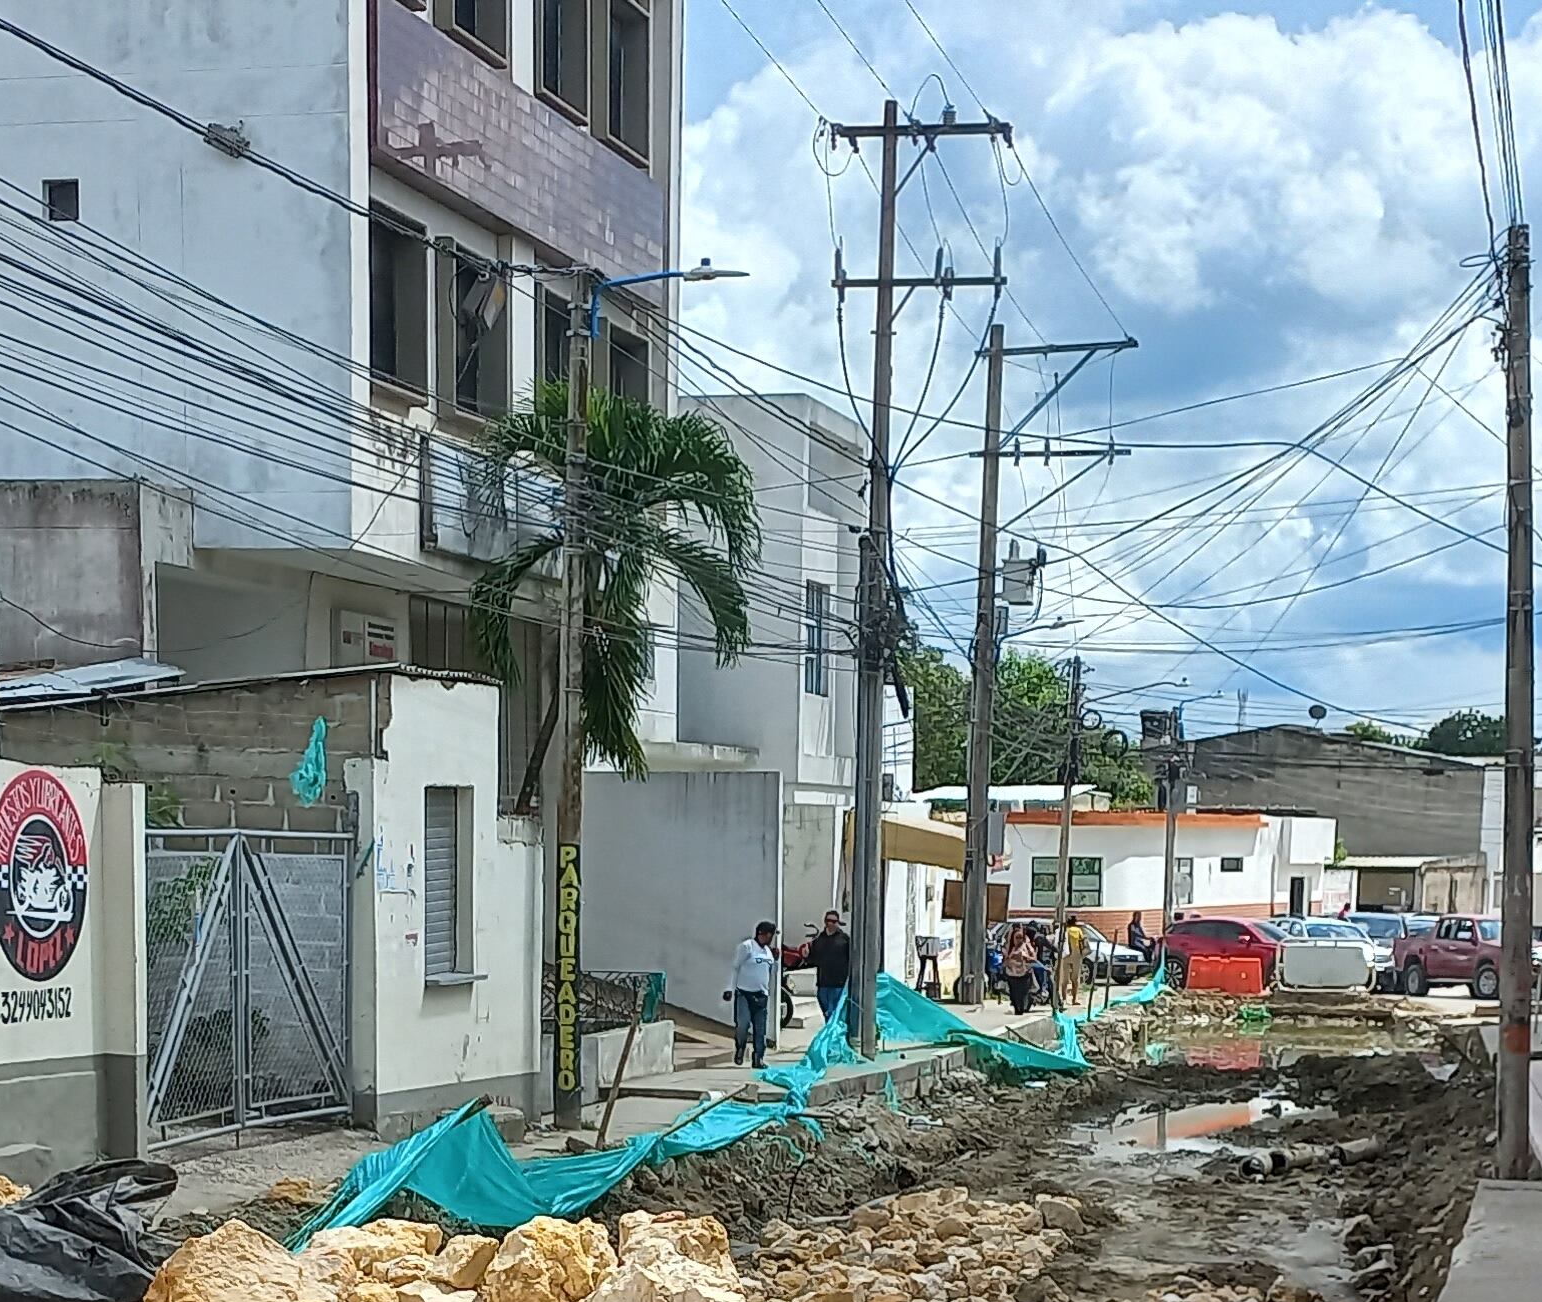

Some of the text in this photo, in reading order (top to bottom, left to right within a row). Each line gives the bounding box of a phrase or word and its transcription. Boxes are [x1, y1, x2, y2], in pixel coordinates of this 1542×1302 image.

[28, 778, 37, 808] Y
[558, 846, 580, 1091] PARQUEADERO
[0, 987, 72, 1025] 3244043152
